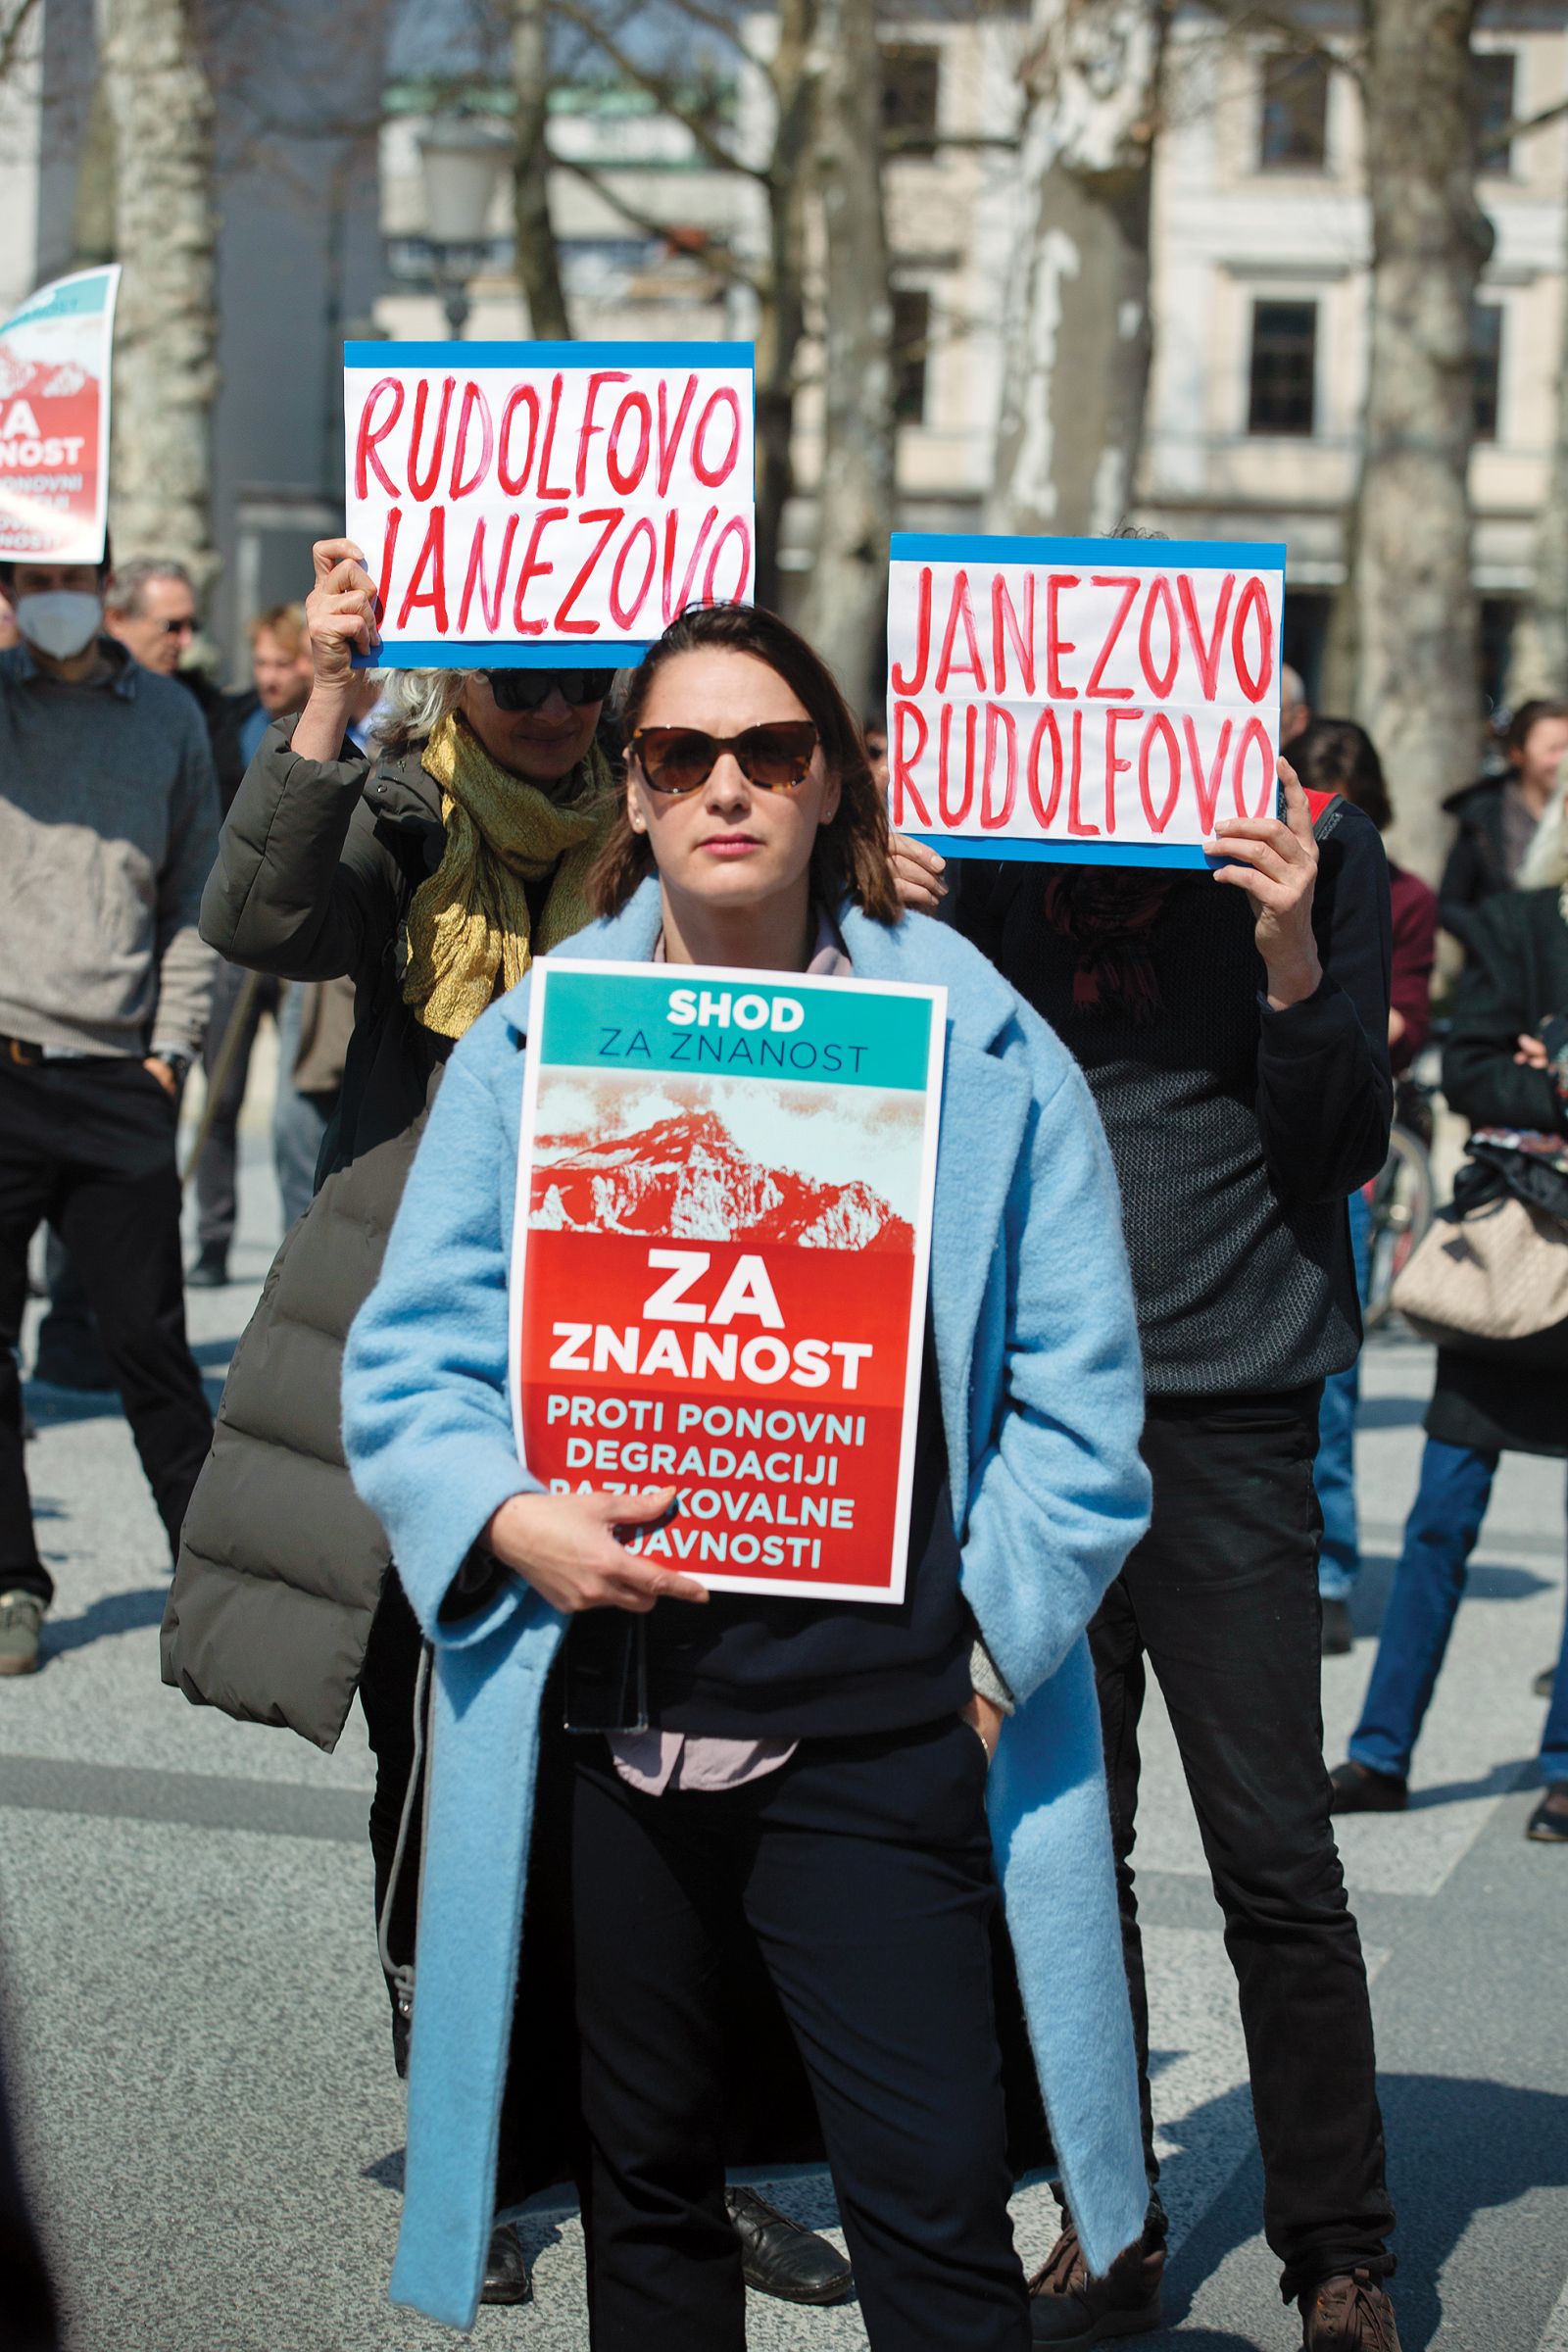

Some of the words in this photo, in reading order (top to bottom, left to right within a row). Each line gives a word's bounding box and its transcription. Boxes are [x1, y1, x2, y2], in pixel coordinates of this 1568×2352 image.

[0, 399, 41, 440] A
[354, 370, 744, 503] RUDOLFOVO
[375, 505, 752, 635] JANEZOVO
[891, 565, 1273, 705] JANEZOVO
[893, 701, 1274, 836] RUDOLFOVO
[666, 989, 805, 1033] SHOD
[599, 1028, 651, 1058] ZA
[669, 1032, 869, 1074] ZNANOST
[643, 1249, 785, 1329] ZA
[549, 1321, 873, 1391] ZNANOST
[547, 1395, 663, 1433] PROTI
[677, 1402, 866, 1446] PONOVNI
[566, 1438, 838, 1487] DEGRADACIJI
